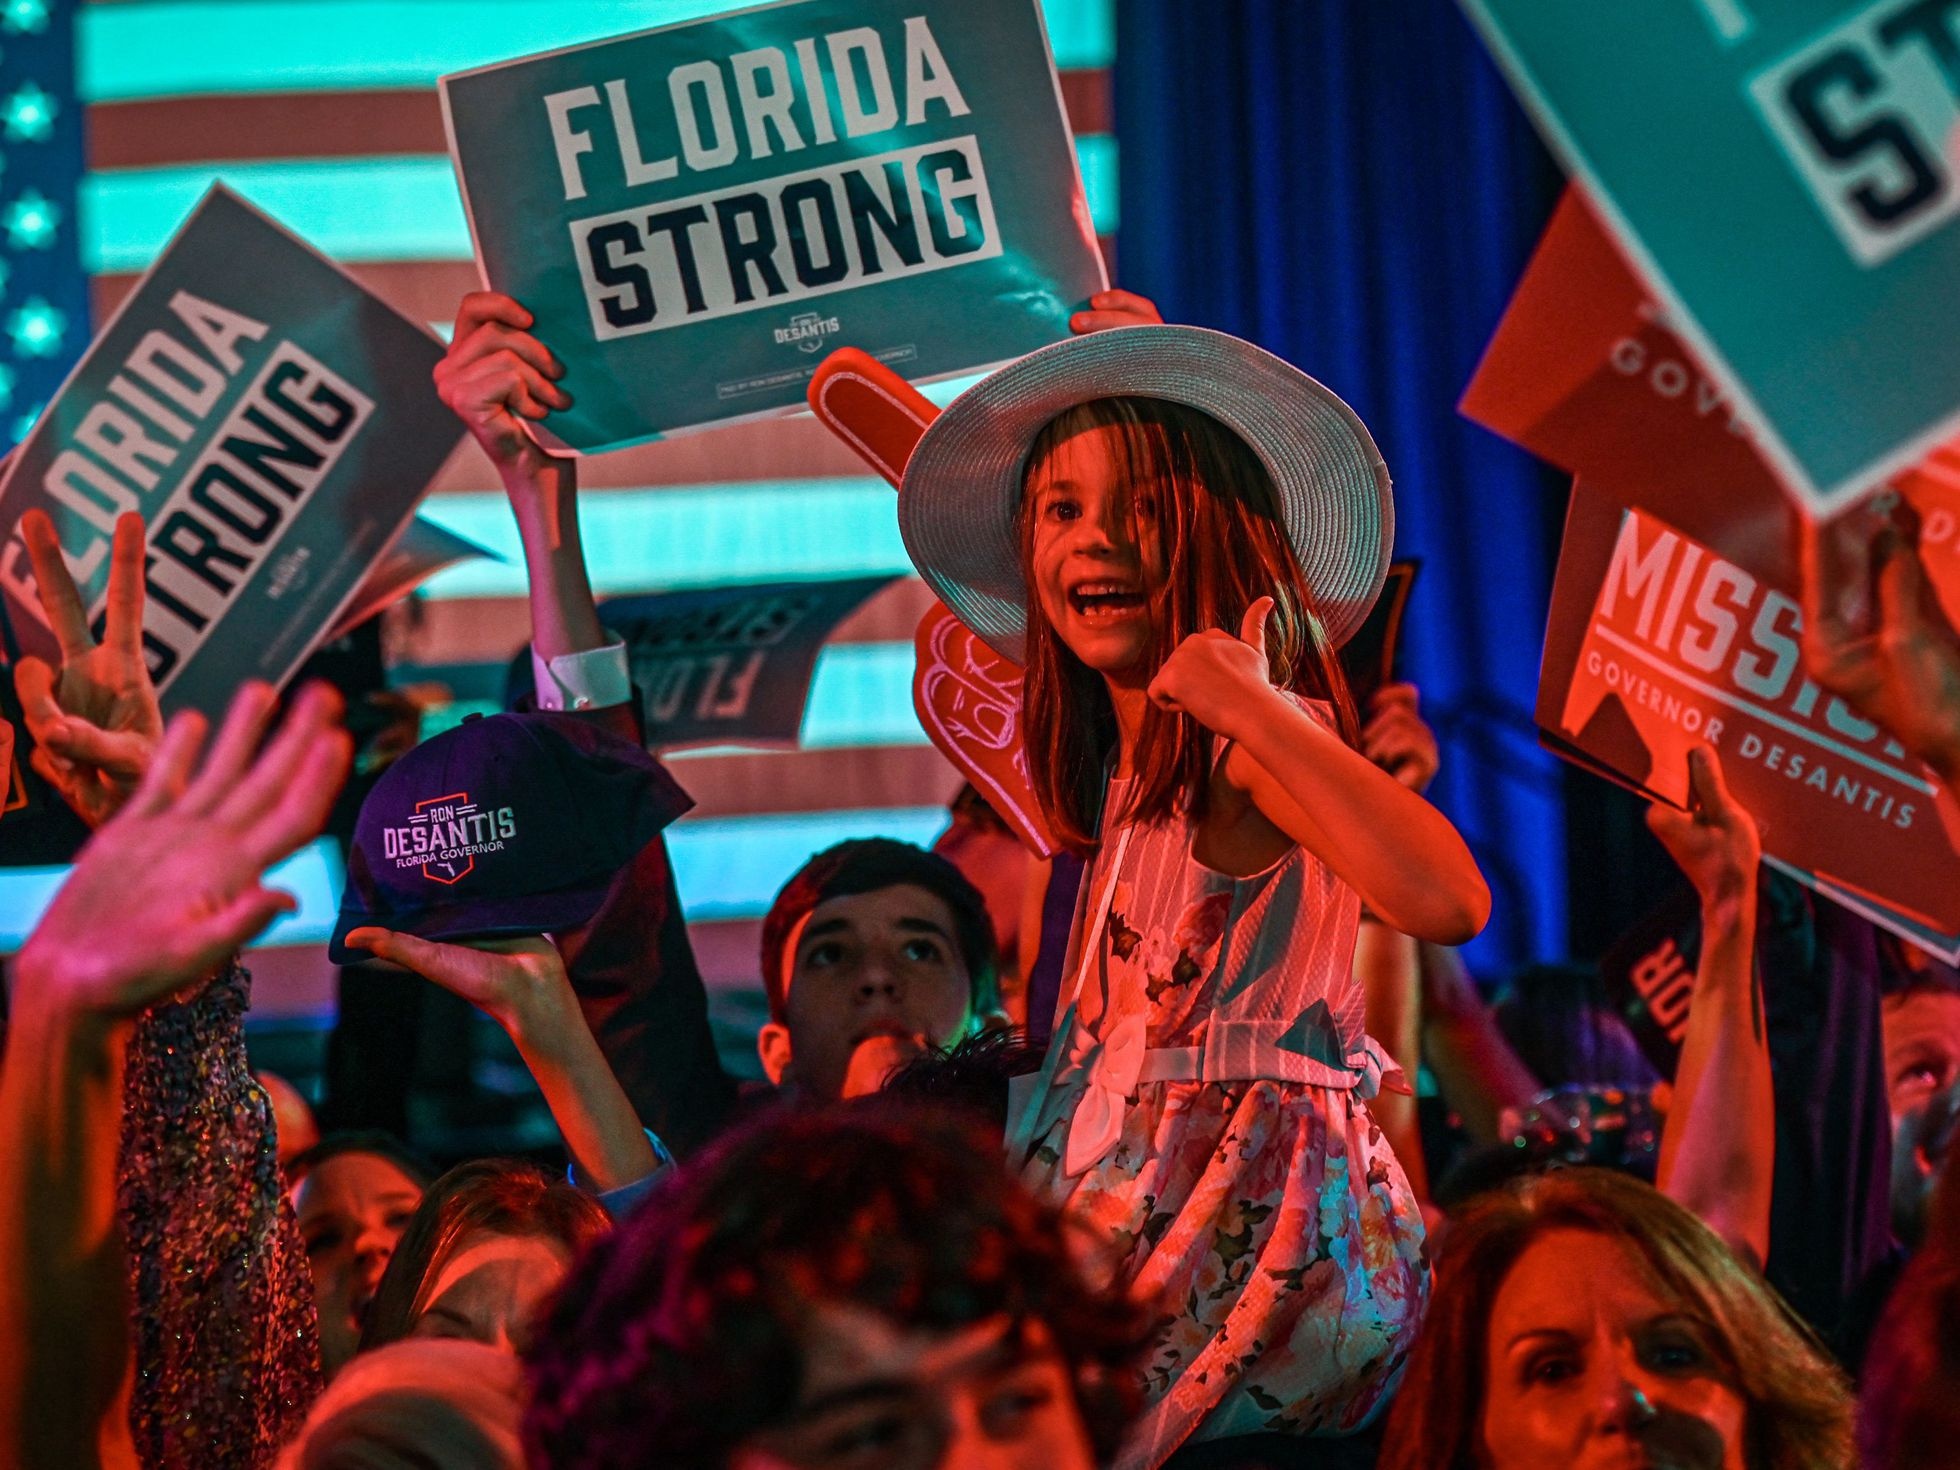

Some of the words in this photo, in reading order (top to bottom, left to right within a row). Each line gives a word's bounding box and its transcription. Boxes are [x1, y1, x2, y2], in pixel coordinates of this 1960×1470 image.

[544, 16, 971, 200] FLORIDA
[586, 148, 986, 329] STRONG
[774, 317, 840, 344] DESANTIS
[1599, 508, 1906, 758] MISS
[1587, 651, 1725, 745] GOVERNOR
[1740, 733, 1917, 829] DESANTIS
[384, 806, 517, 859] DESANTIS
[396, 852, 437, 869] FLORIDA
[439, 839, 505, 861] GOVERNOR
[430, 804, 455, 824] RON
